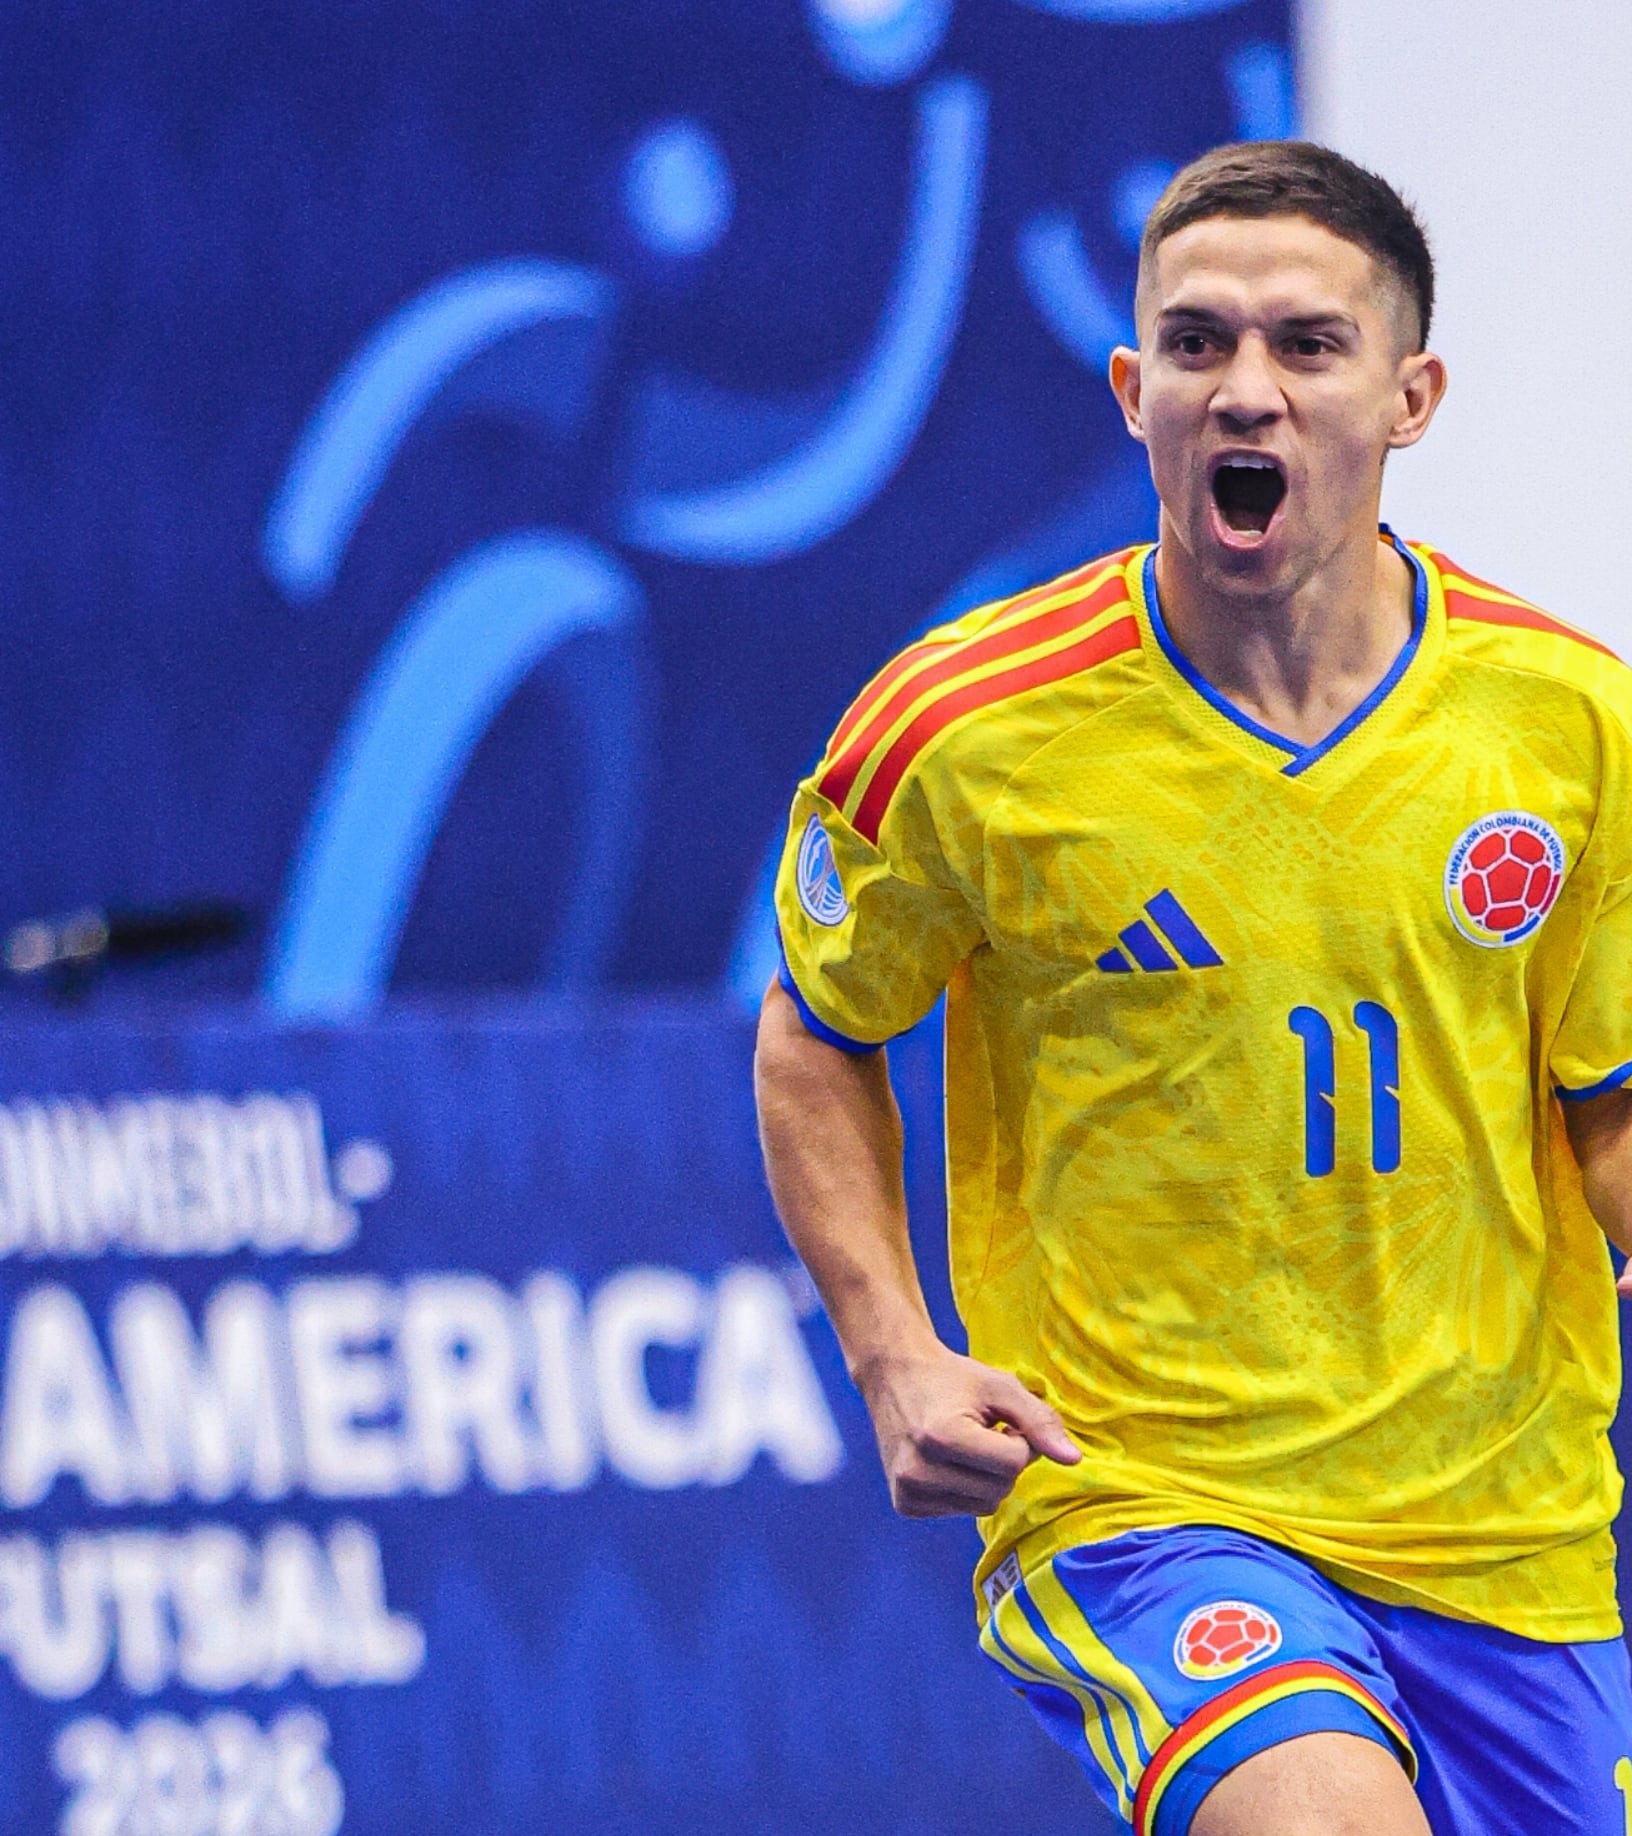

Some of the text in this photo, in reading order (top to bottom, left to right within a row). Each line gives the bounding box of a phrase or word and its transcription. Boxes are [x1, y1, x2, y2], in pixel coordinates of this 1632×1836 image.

[1480, 816, 1540, 833] COLOMBIANA
[1540, 827, 1551, 841] DE
[1288, 1000, 1401, 1178] 11
[2, 1265, 845, 1508] AMERICA
